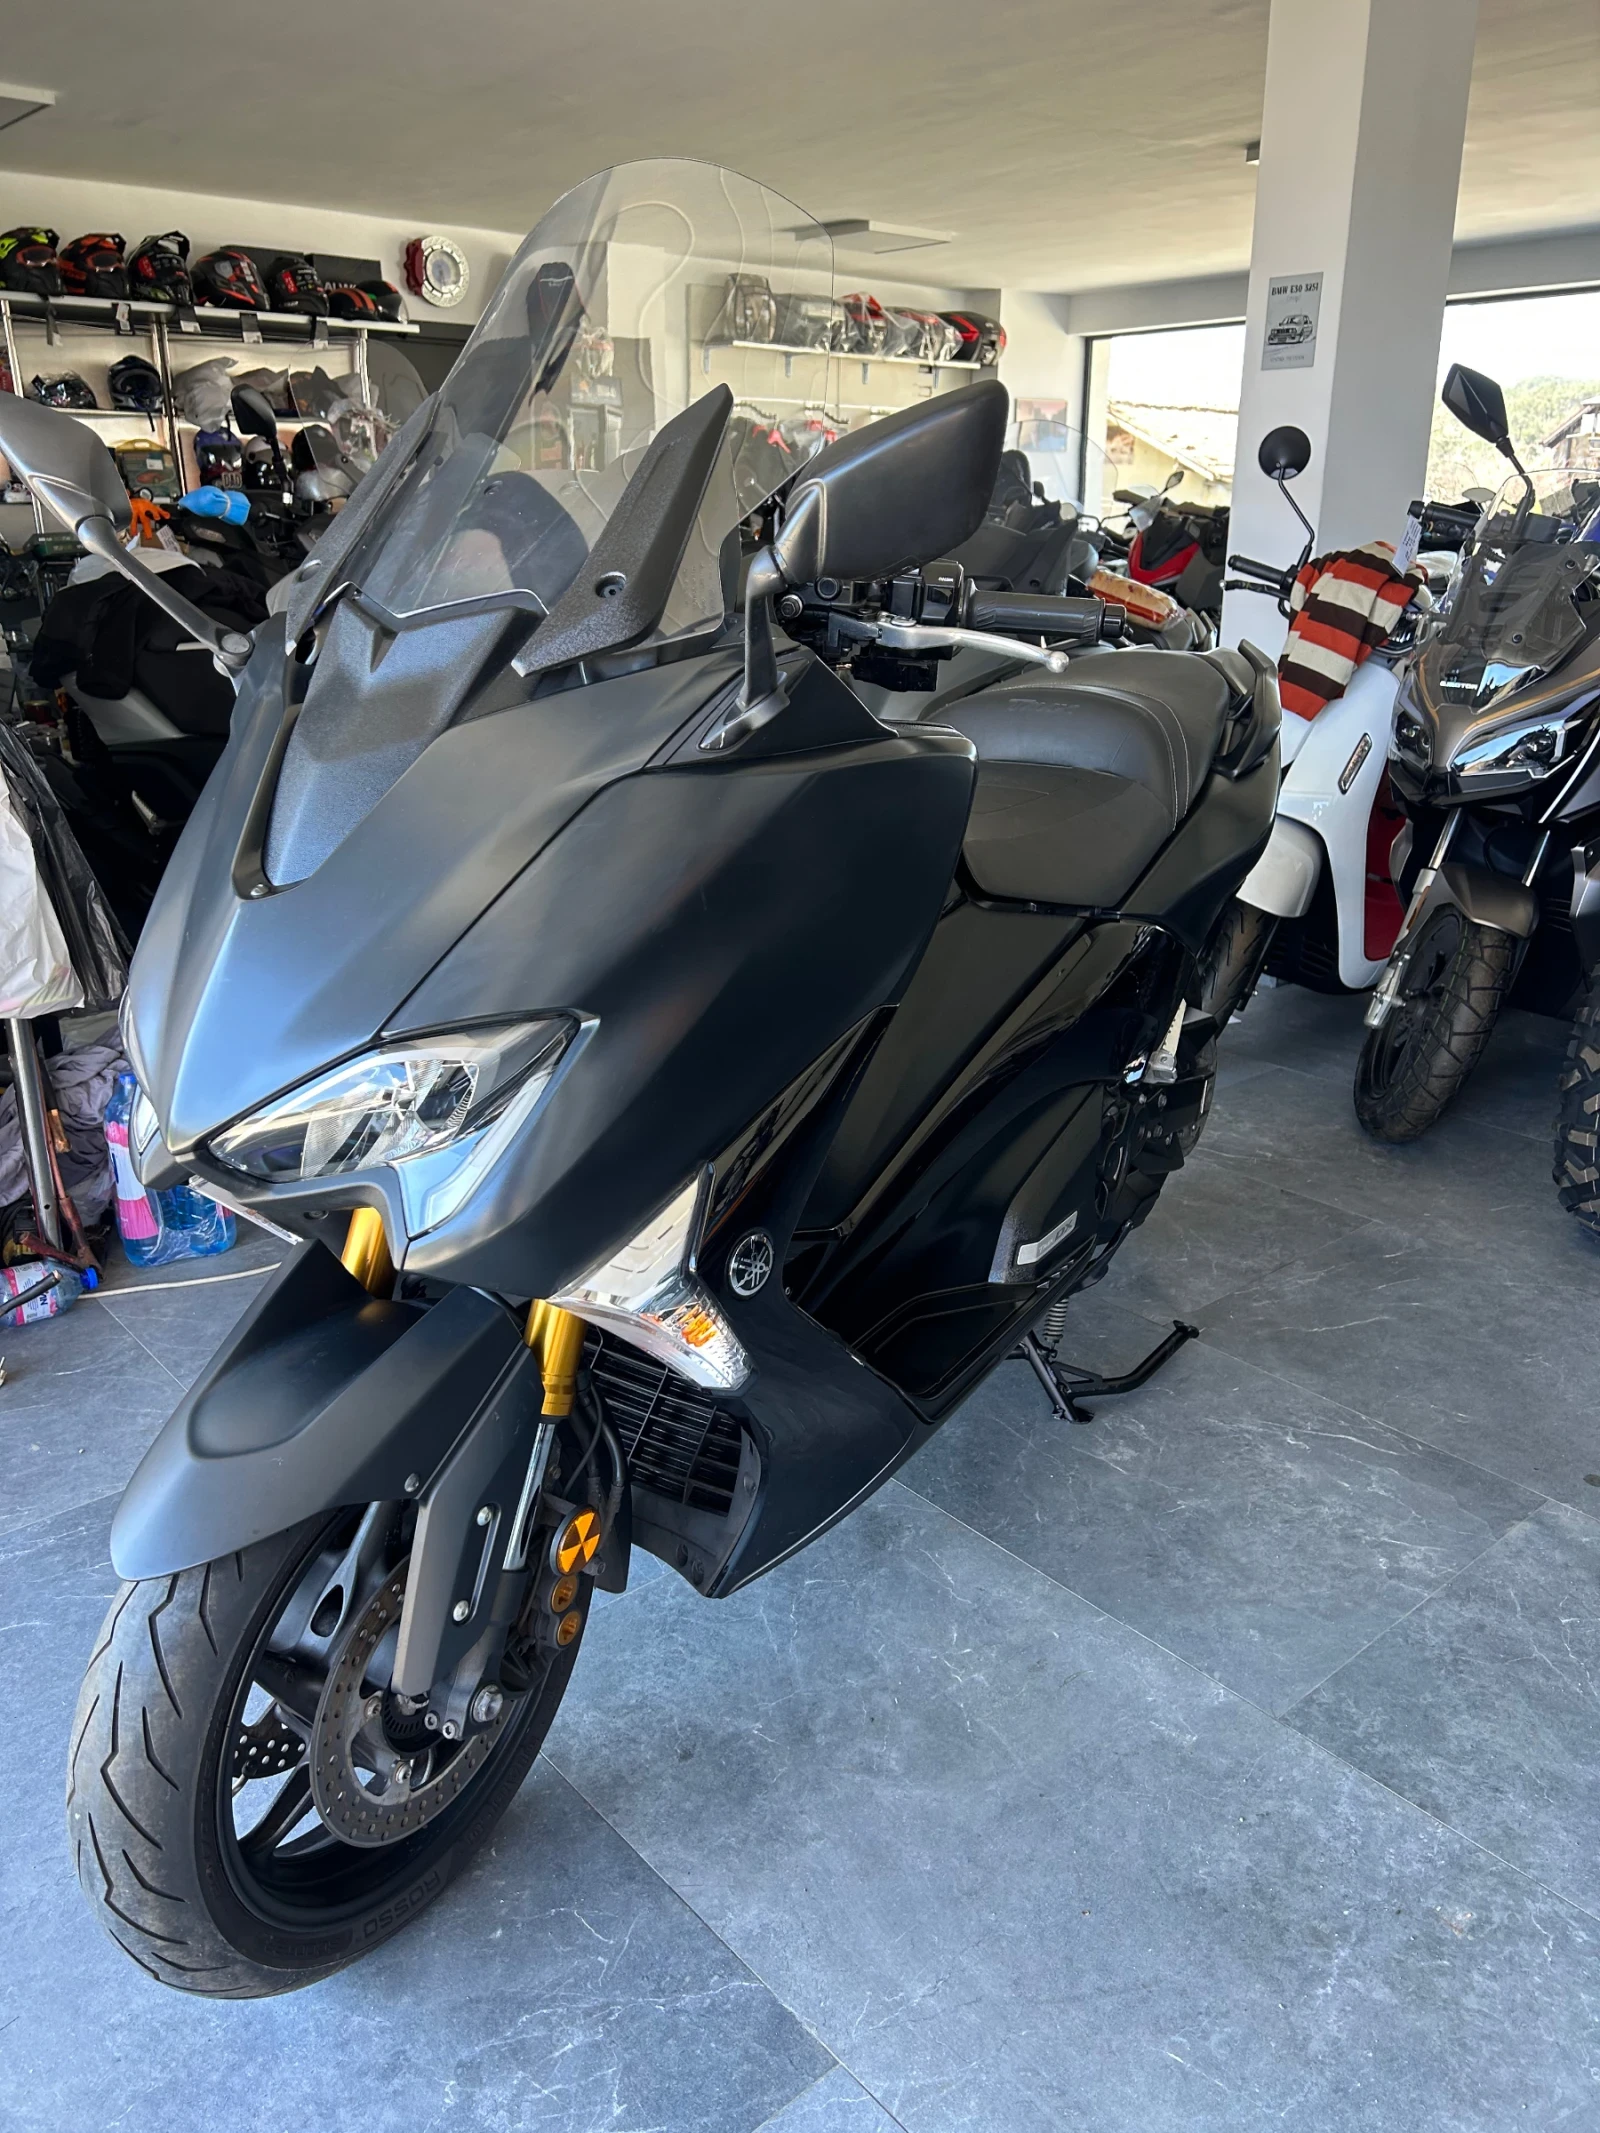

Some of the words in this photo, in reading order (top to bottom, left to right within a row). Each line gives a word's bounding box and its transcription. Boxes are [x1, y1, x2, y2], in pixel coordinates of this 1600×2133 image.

[1271, 286, 1289, 296] BMW
[1290, 284, 1303, 294] E30
[362, 1870, 441, 1939] ROSSO
